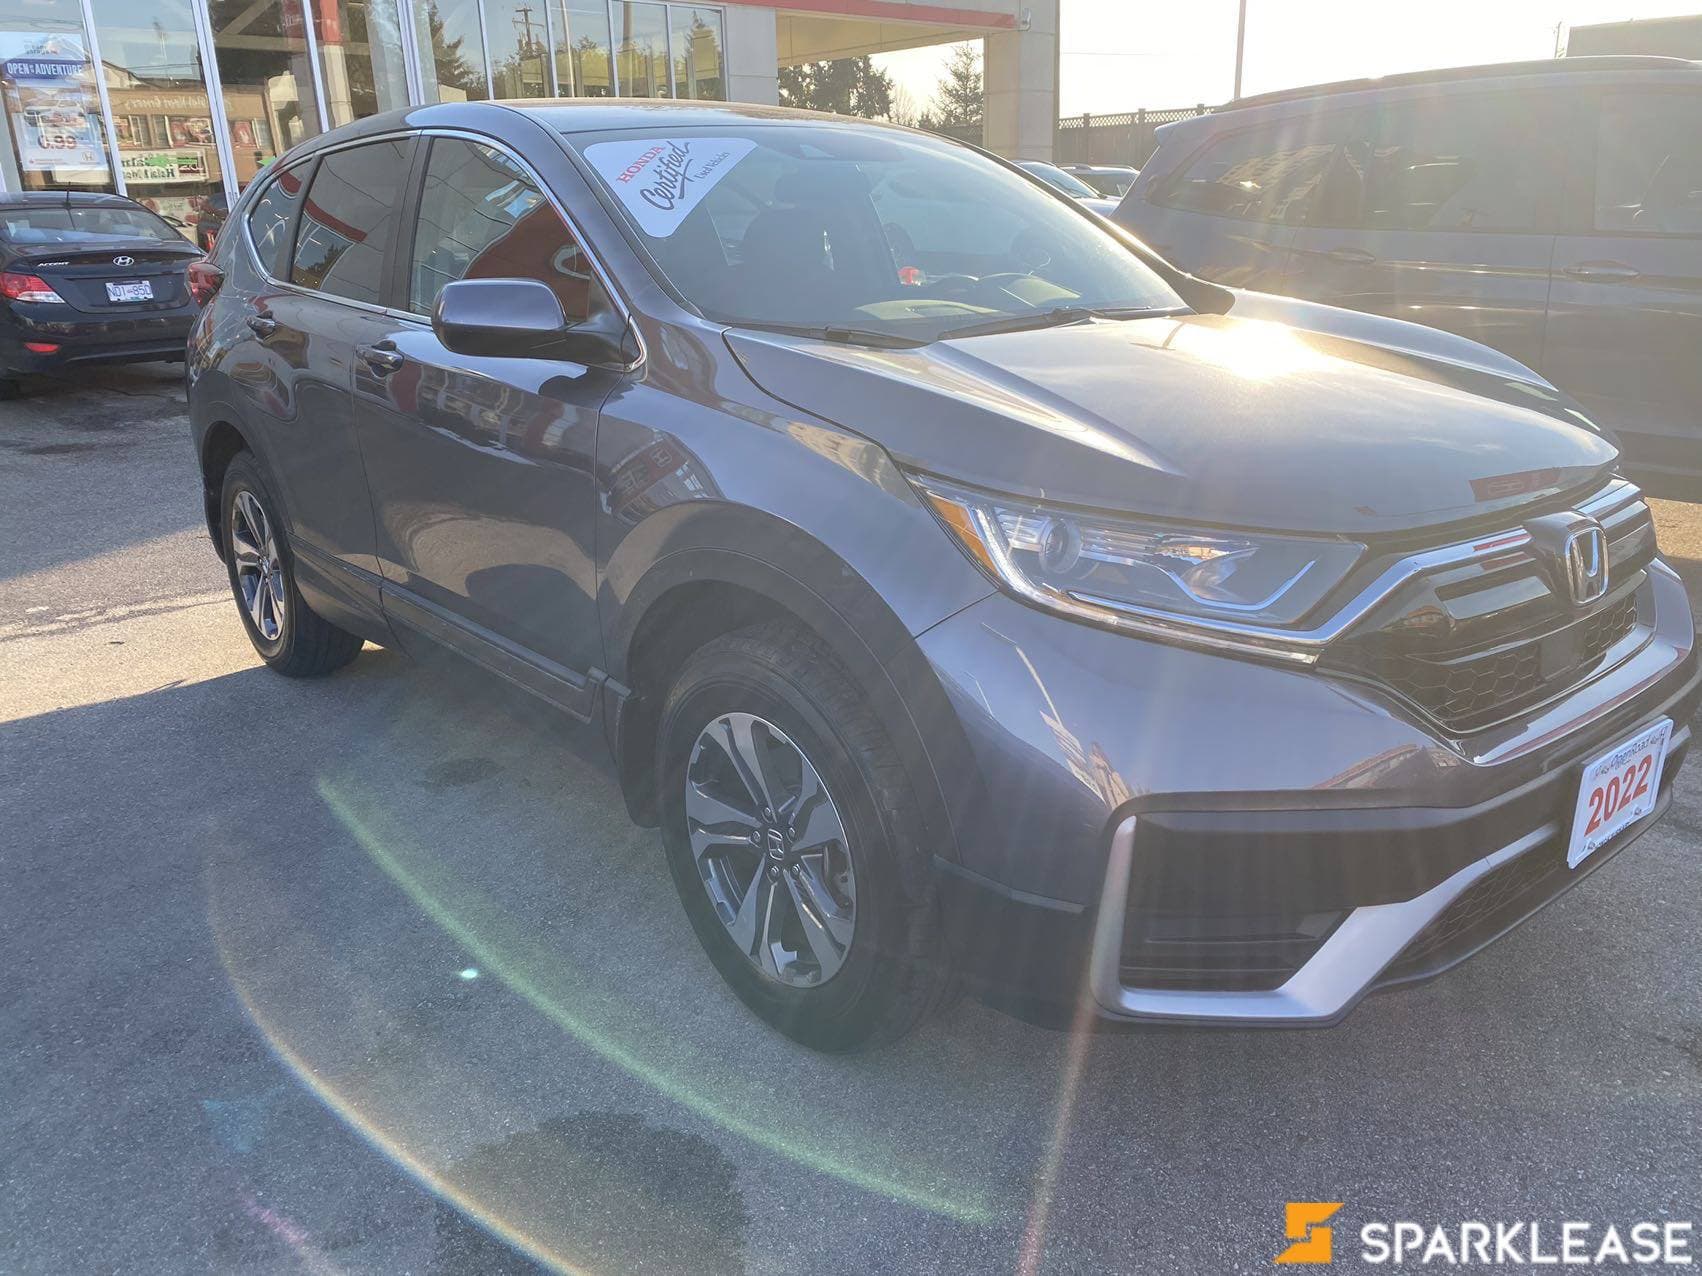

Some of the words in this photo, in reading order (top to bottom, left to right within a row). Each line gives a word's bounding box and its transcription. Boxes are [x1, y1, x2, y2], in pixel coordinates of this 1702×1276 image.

[7, 63, 29, 74] OPEN
[35, 63, 82, 76] ADVENTURE
[617, 146, 664, 183] HONDA
[640, 141, 691, 211] Certified
[1585, 755, 1653, 837] 2022
